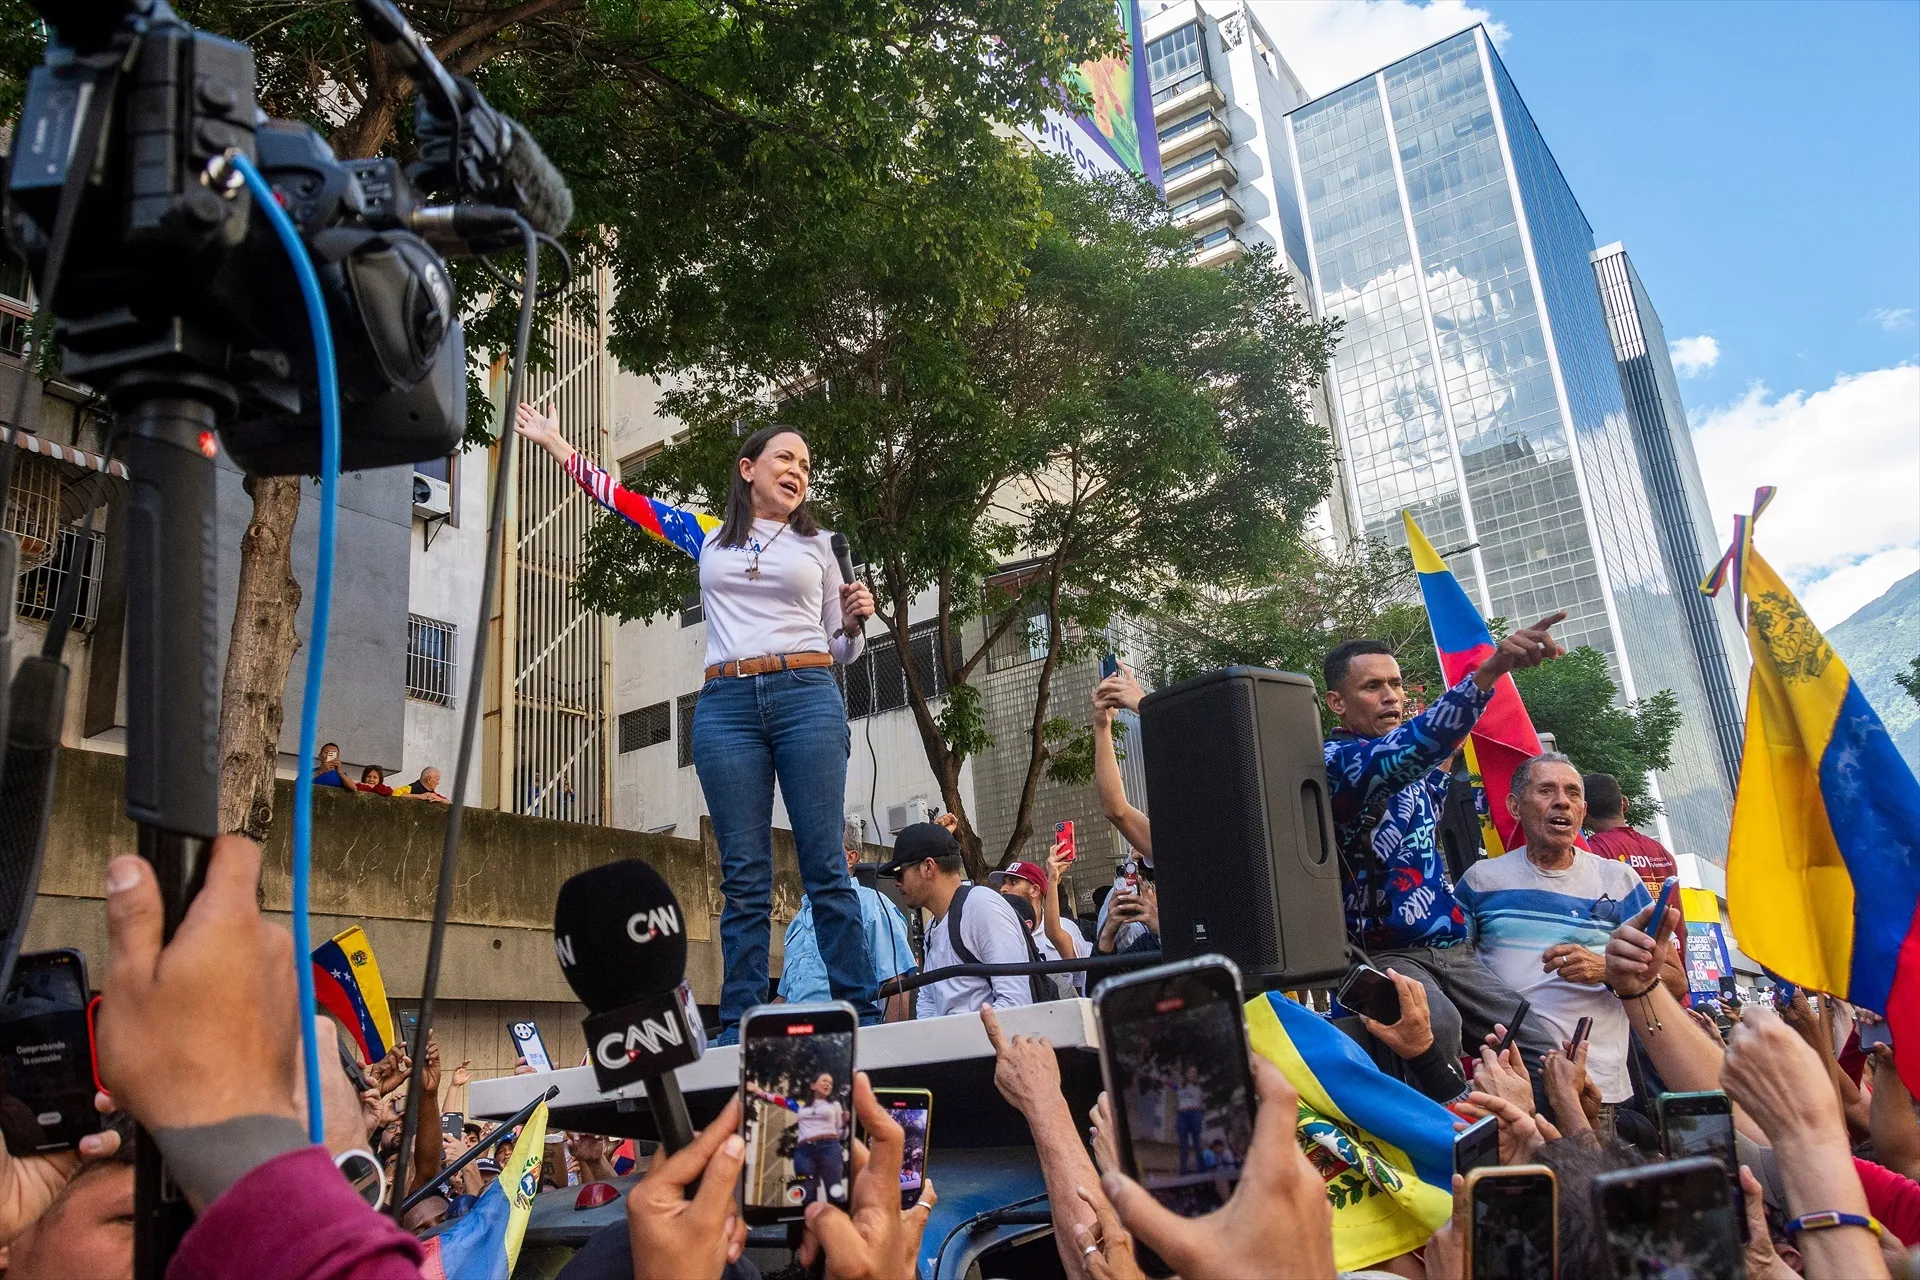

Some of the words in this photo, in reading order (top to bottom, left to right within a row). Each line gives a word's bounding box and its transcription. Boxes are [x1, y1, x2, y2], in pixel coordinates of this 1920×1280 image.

[1399, 886, 1435, 925] nike
[627, 904, 680, 944] CNN
[1196, 924, 1205, 932] JBL
[16, 1041, 66, 1054] Comprobando
[597, 1010, 684, 1069] CNN
[23, 1057, 30, 1065] la
